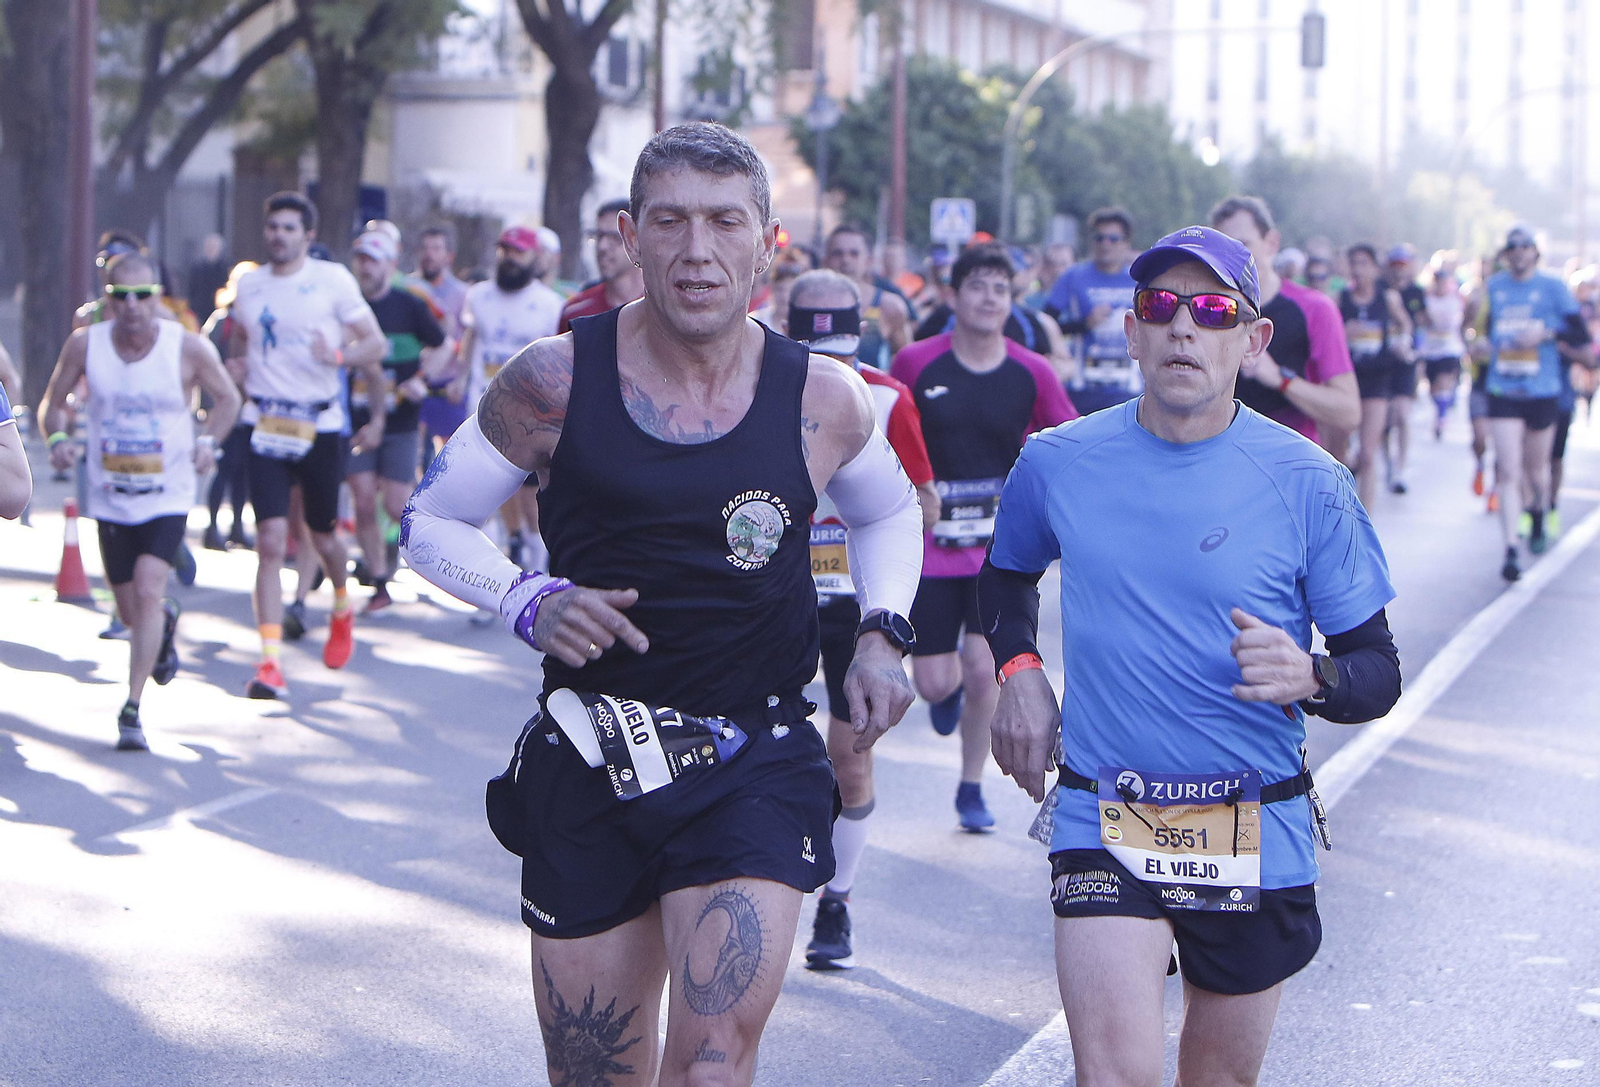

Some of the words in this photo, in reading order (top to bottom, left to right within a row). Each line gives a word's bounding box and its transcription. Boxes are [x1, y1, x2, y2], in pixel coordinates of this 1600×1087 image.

[721, 490, 770, 519] NACIDOS
[771, 496, 792, 526] PARA
[437, 558, 501, 594] TROTASIERRA
[607, 763, 624, 796] ZURICH
[1150, 779, 1240, 800] ZURICH
[1153, 827, 1209, 849] 5551
[1145, 857, 1166, 875] EL
[1170, 861, 1219, 879] VIEJO
[1220, 903, 1253, 912] ZURICH
